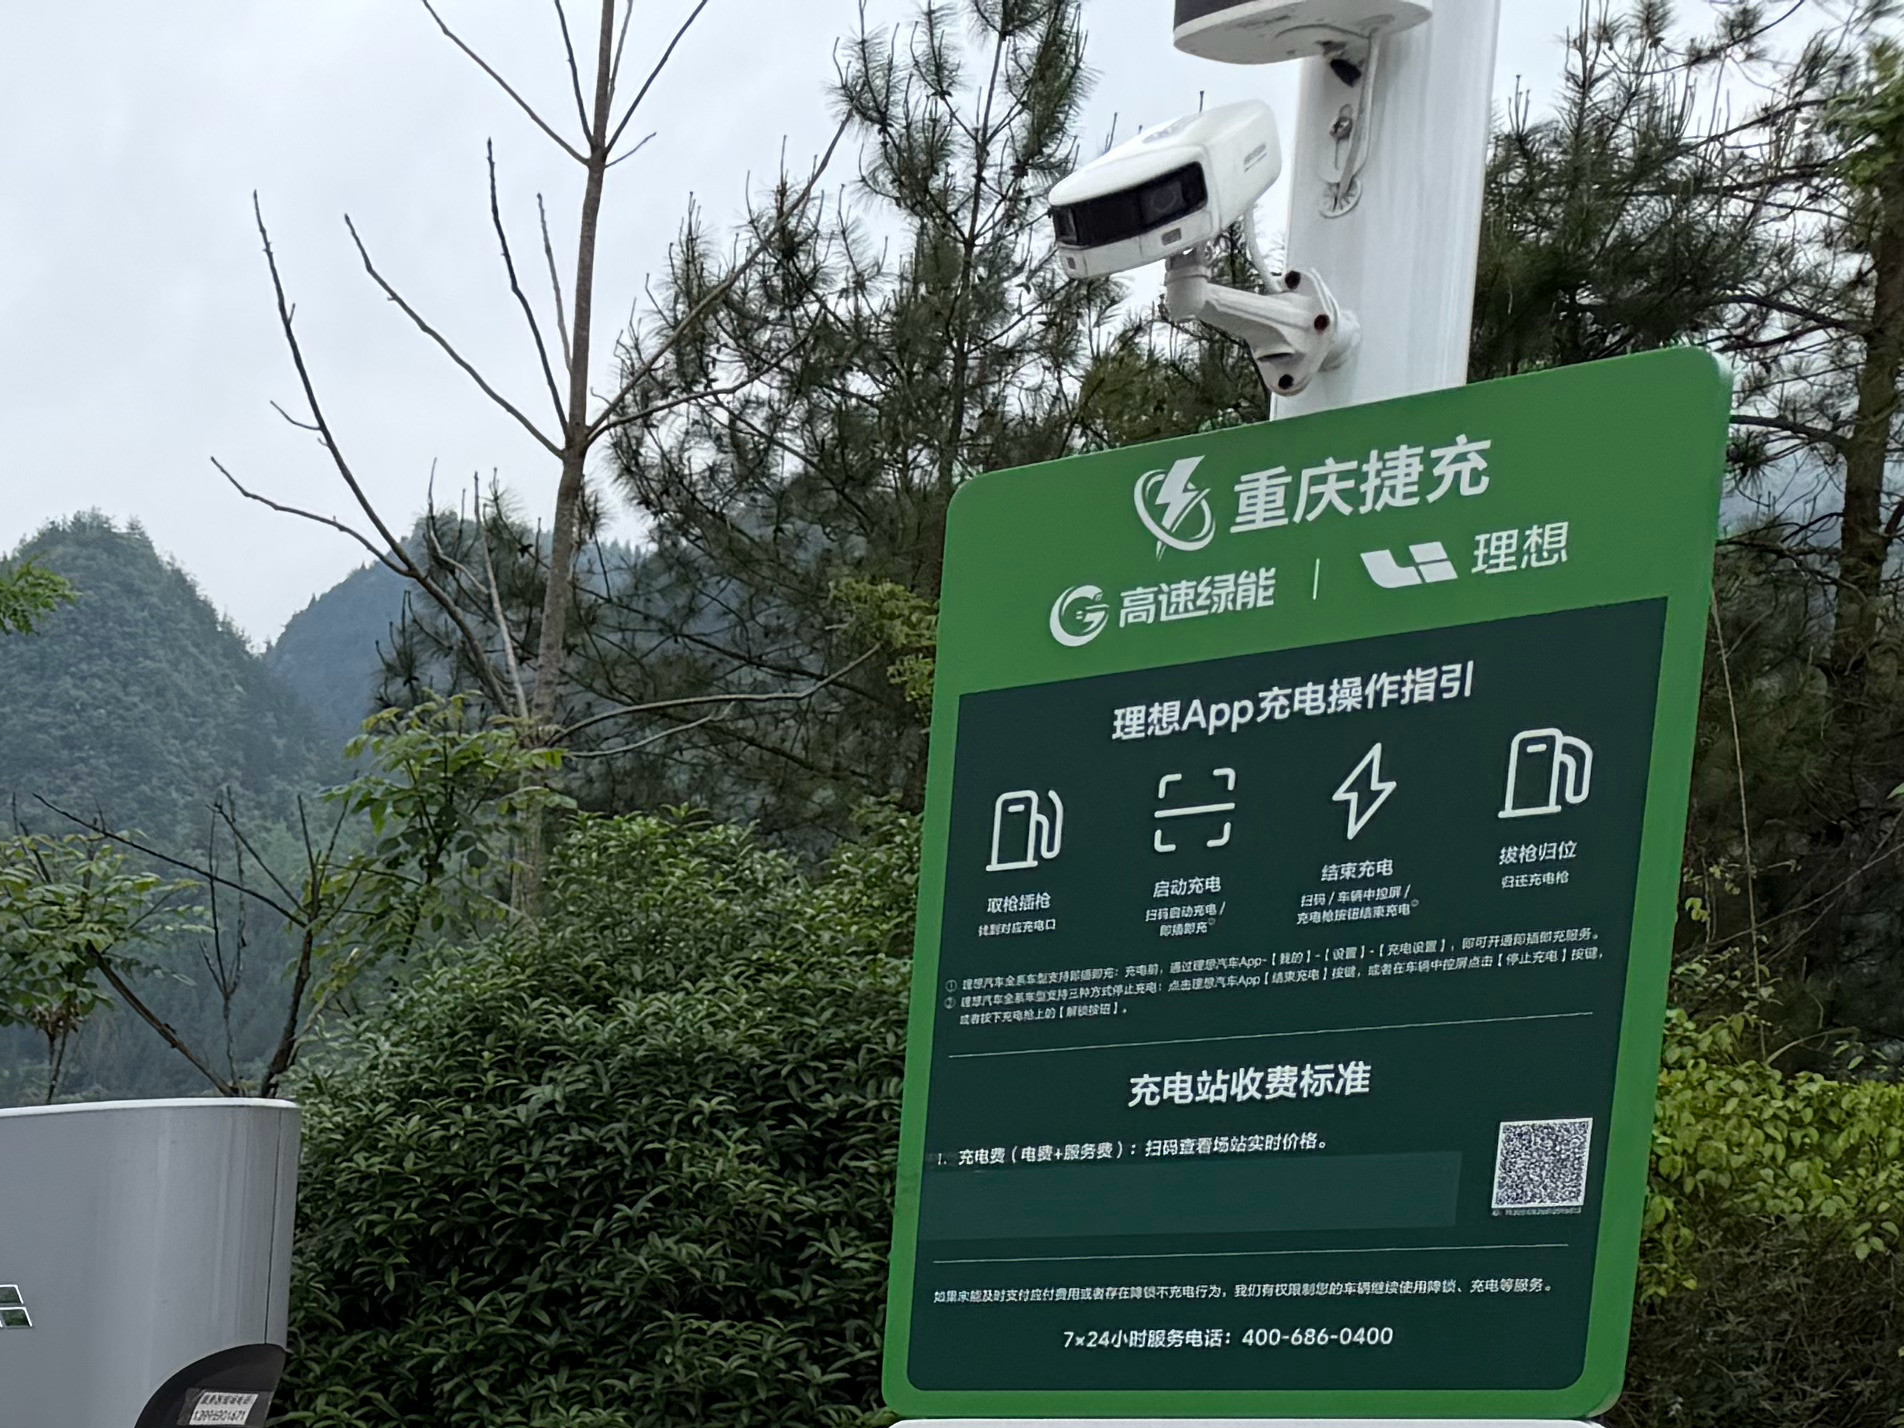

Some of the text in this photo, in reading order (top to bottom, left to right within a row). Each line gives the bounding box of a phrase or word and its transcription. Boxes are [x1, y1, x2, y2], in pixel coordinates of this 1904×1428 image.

[1231, 434, 1492, 534] 重庆捷充
[1471, 522, 1569, 576] 理想
[1118, 567, 1277, 627] 高速绿能
[1112, 661, 1475, 742] 理想App充电操作指引
[1499, 840, 1578, 865] 拔枪归位
[1321, 858, 1393, 881] 结束充电
[1501, 870, 1569, 888] 归还充电枪
[1153, 875, 1221, 898] 启动充电
[987, 892, 1051, 913] 取枪插枪
[978, 919, 1056, 937] 找到对应充电口
[1128, 1060, 1371, 1108] 充电站收费标准
